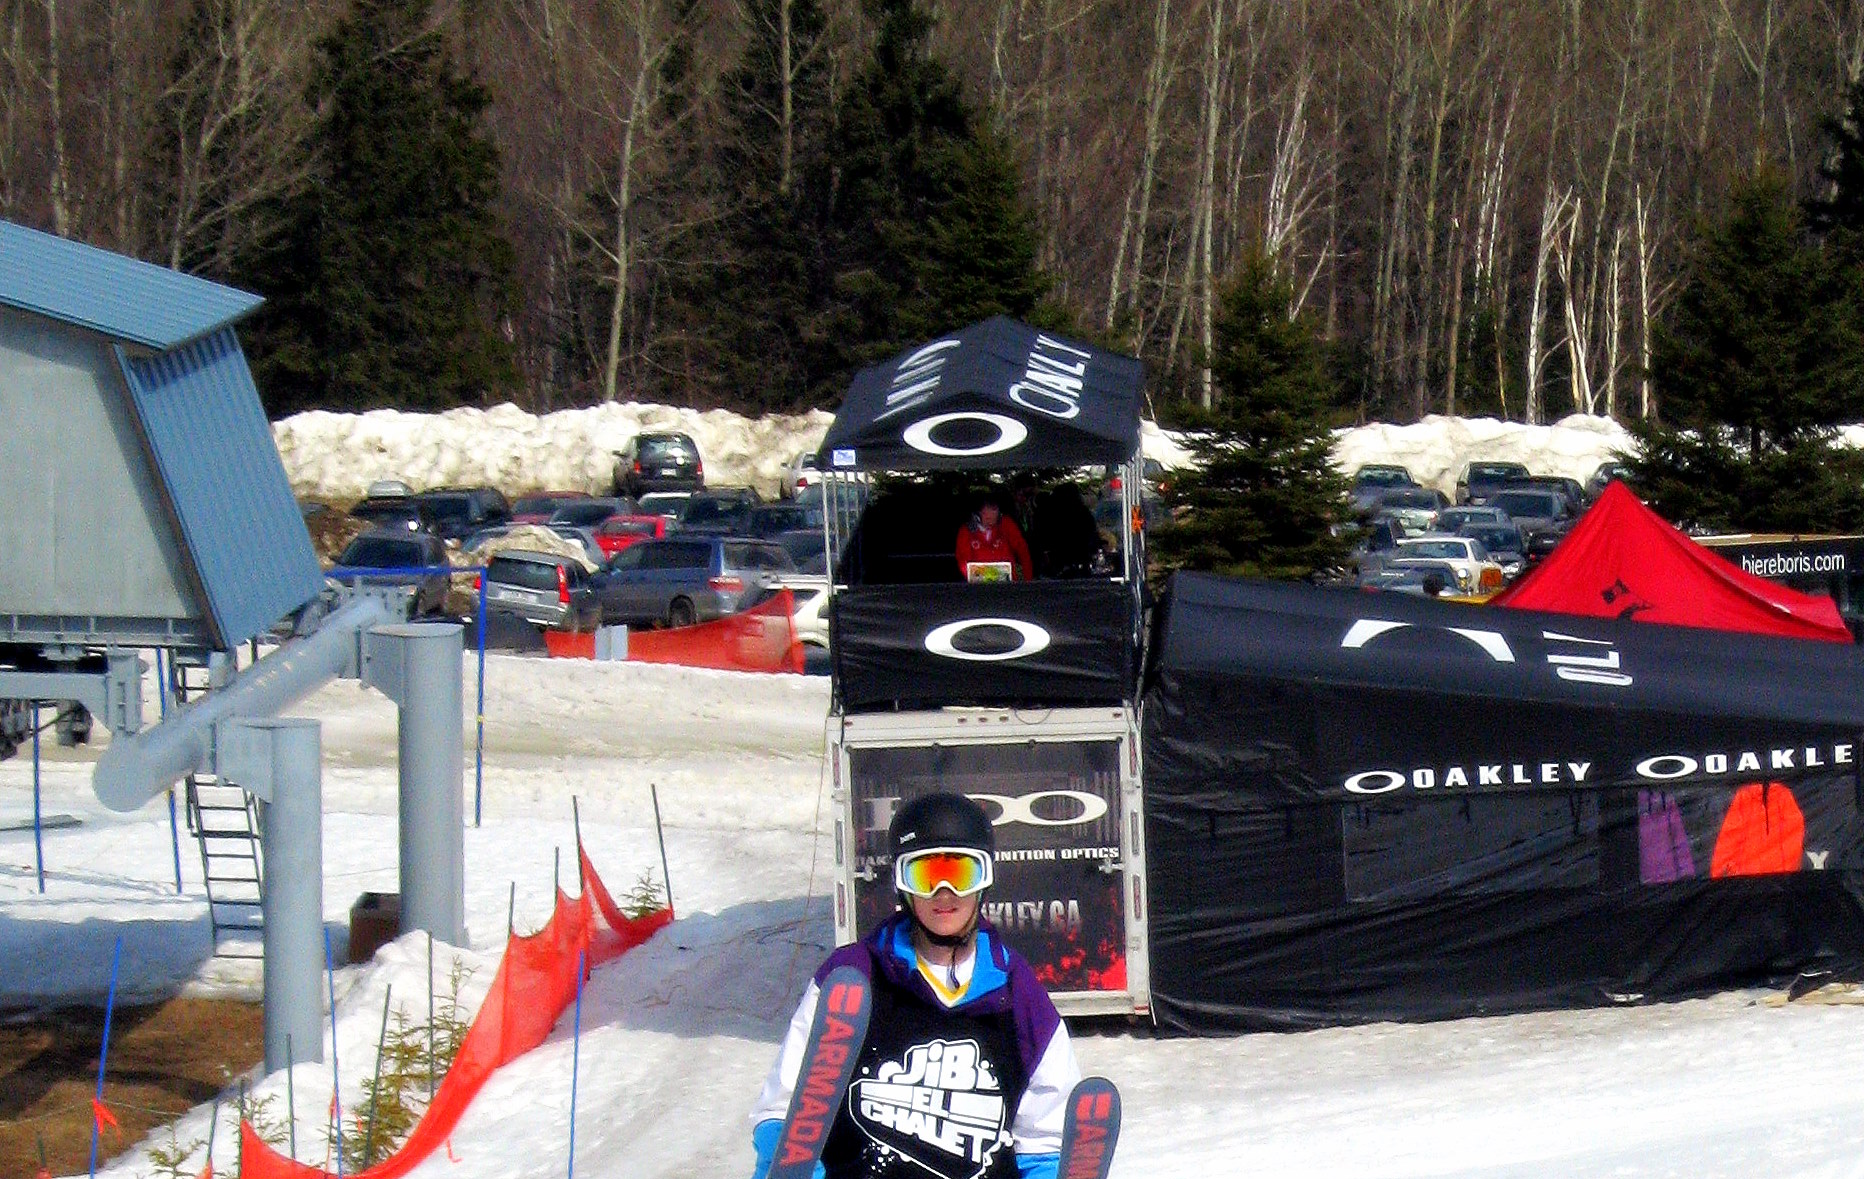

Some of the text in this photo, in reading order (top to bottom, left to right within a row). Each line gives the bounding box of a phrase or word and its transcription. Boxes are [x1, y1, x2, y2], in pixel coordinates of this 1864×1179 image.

[1705, 744, 1854, 774] OAKLE
[1413, 762, 1592, 789] OAKLEY
[994, 849, 1056, 863] INITION
[1060, 847, 1119, 860] OPTICS
[780, 1015, 856, 1167] ARMADA
[861, 1100, 997, 1164] CHALET
